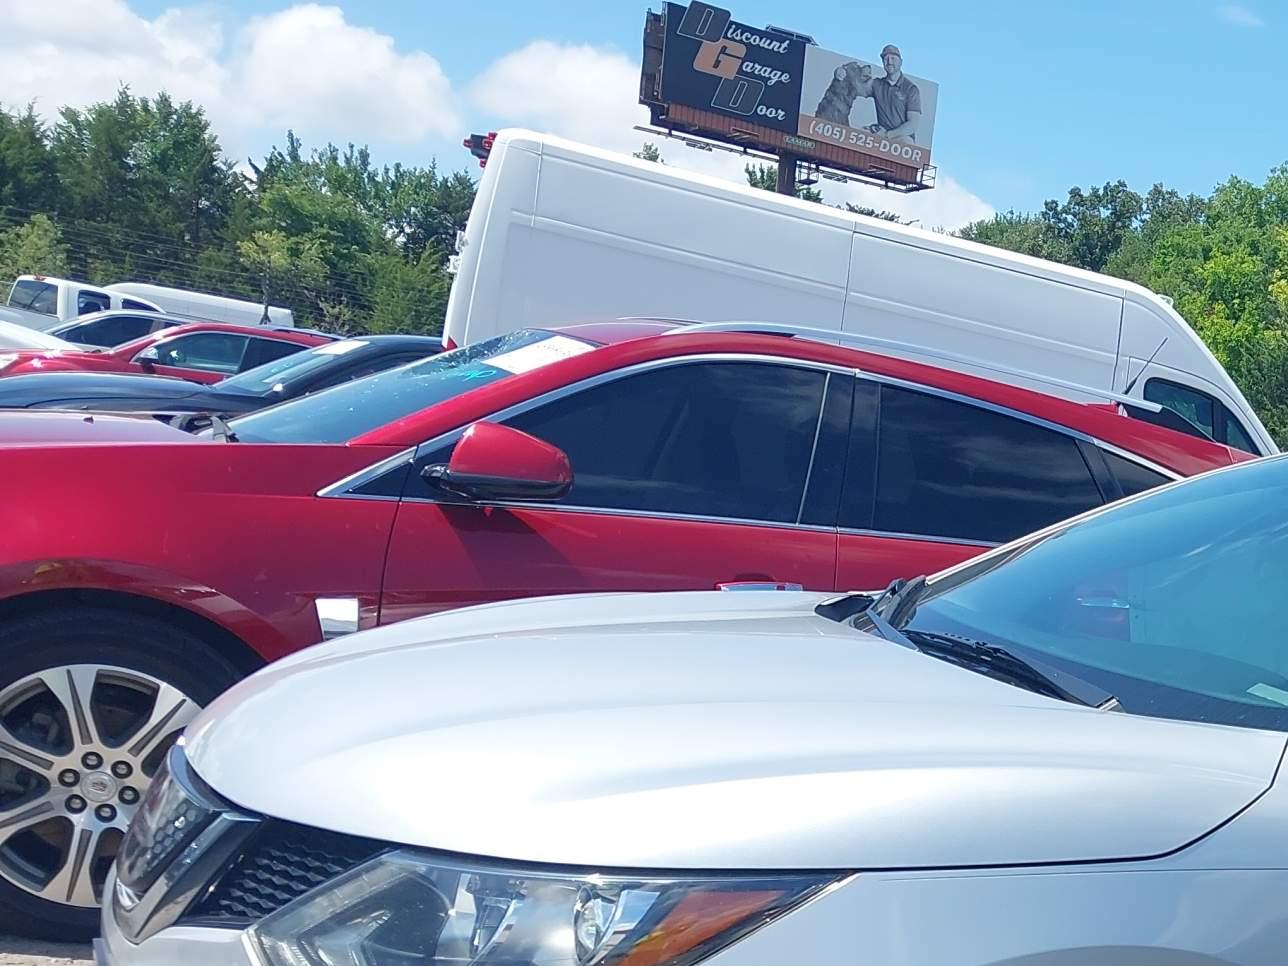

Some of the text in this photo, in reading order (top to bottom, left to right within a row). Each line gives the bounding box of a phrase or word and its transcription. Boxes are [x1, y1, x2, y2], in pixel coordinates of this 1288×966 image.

[676, 1, 790, 55] Discount
[693, 39, 792, 84] Garage
[711, 74, 787, 121] Door
[809, 120, 846, 142] (405)
[849, 131, 922, 162] 525-DOOR
